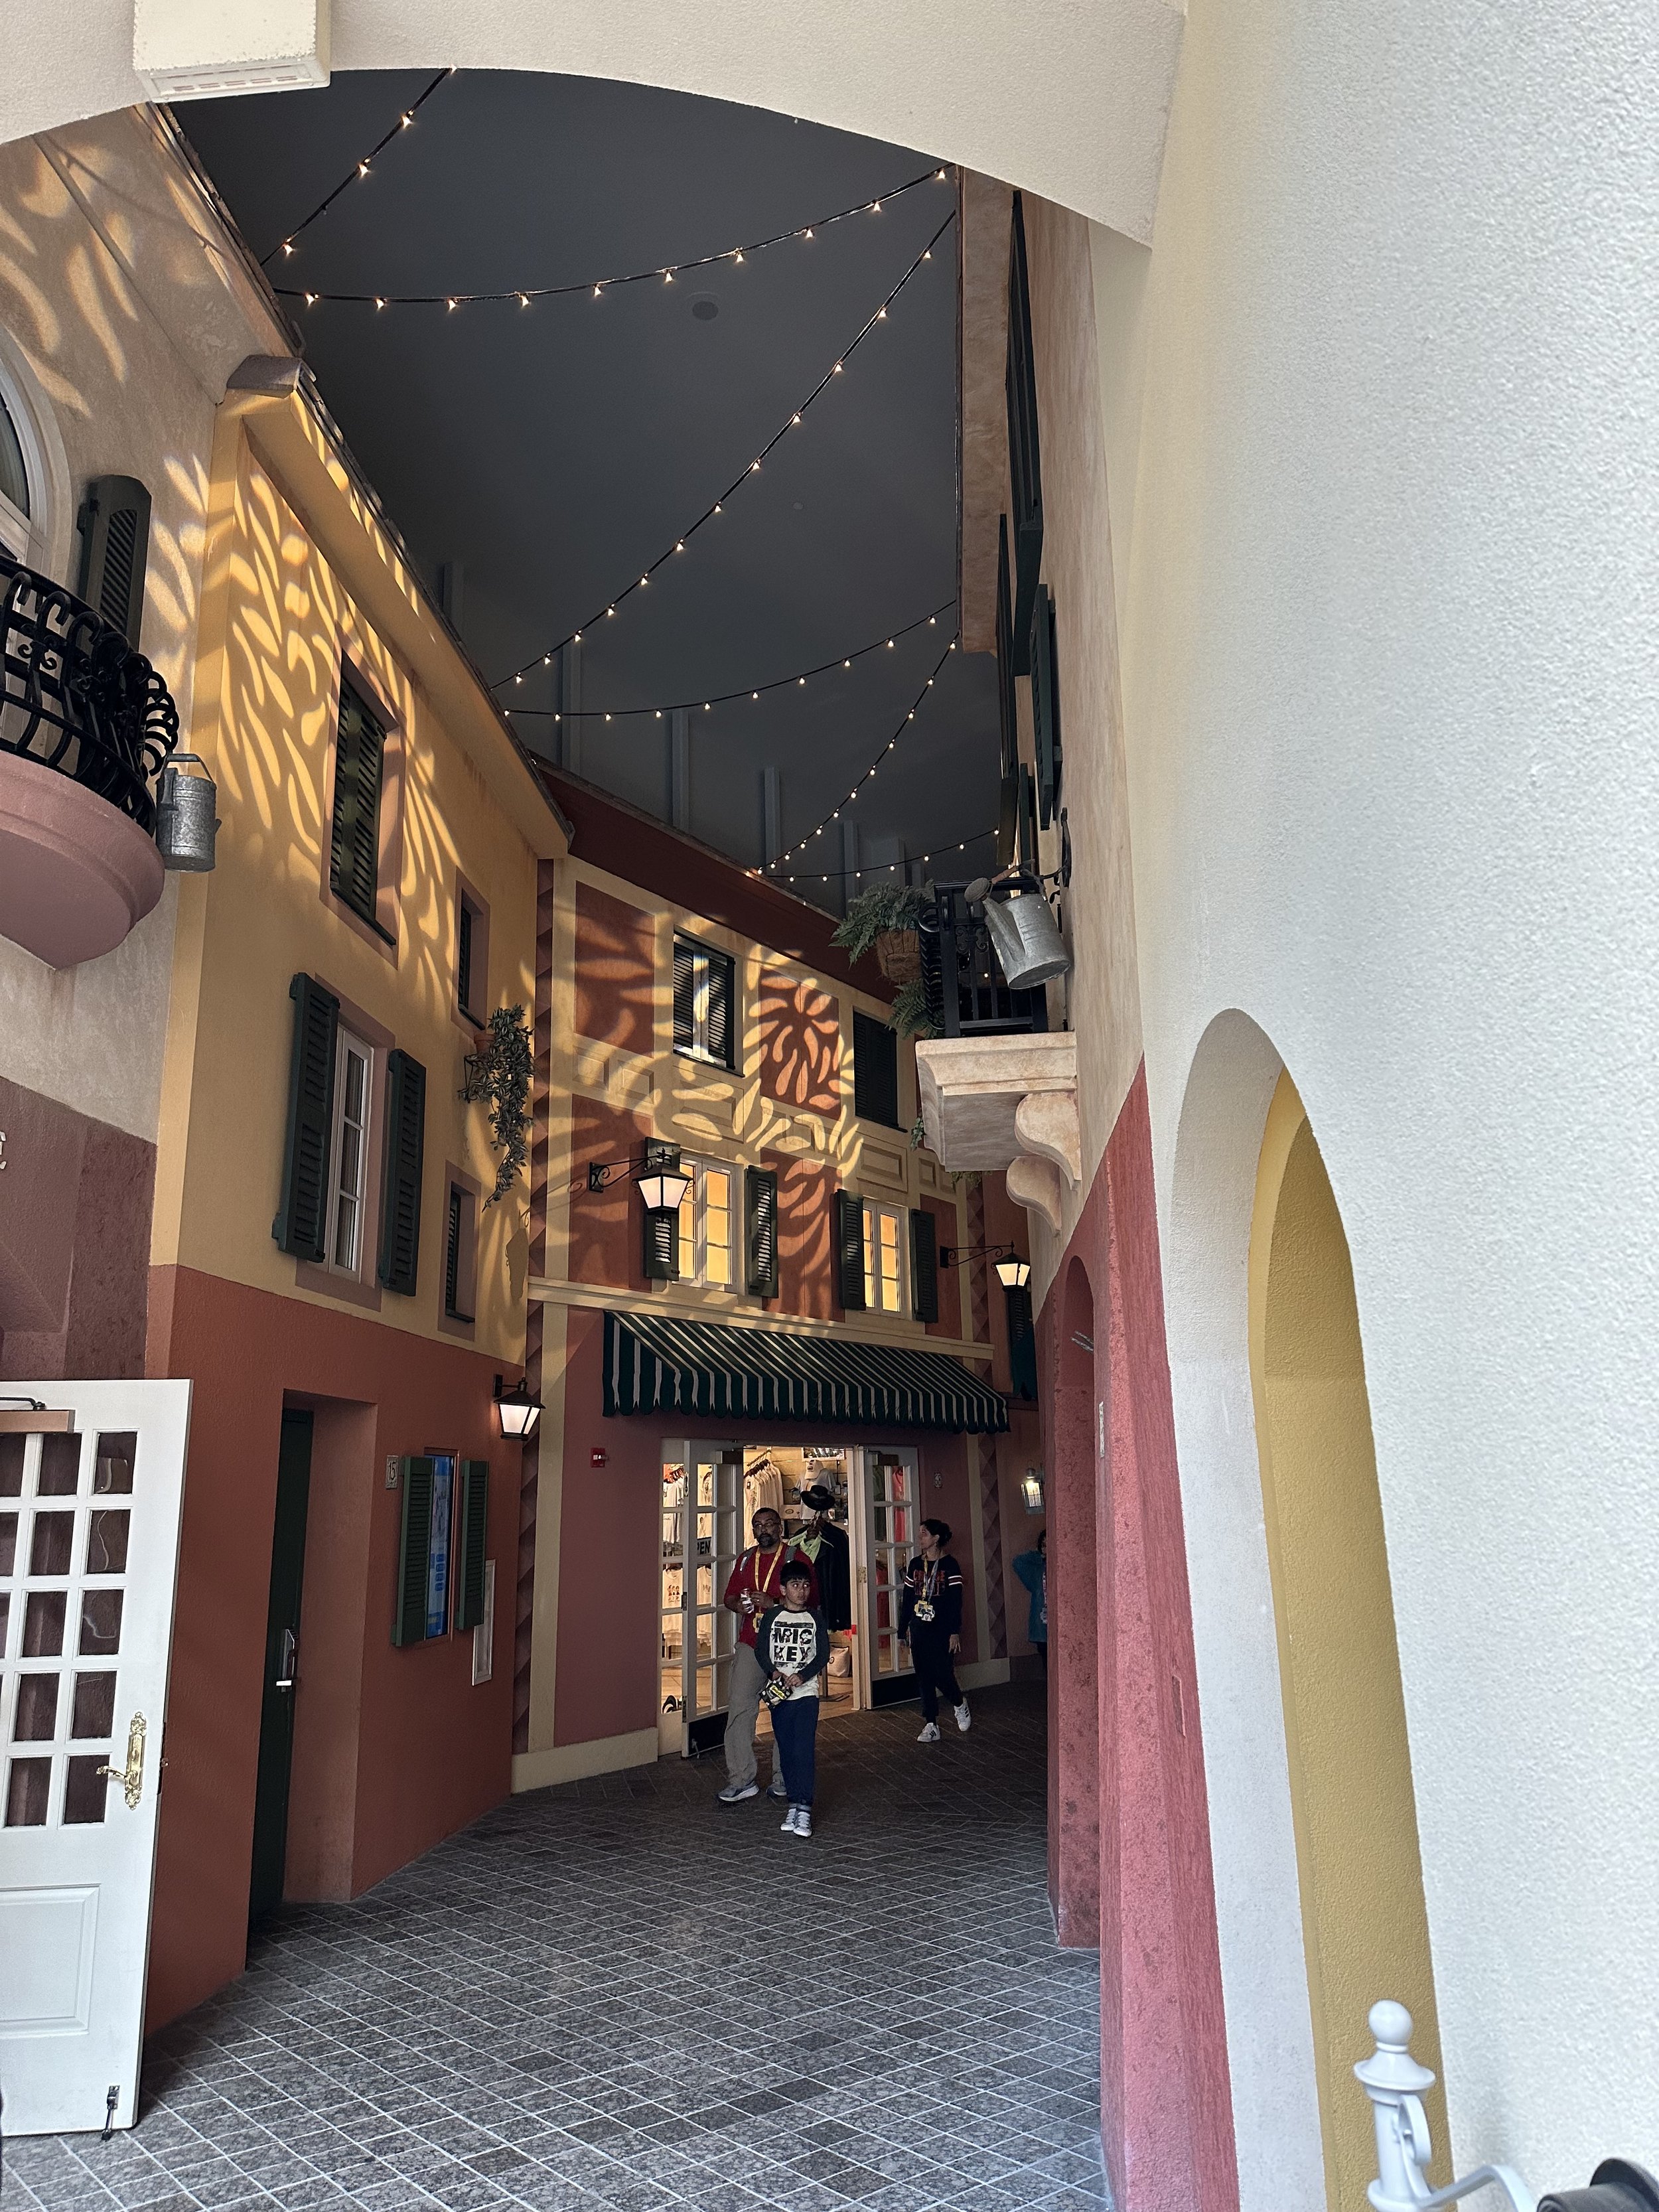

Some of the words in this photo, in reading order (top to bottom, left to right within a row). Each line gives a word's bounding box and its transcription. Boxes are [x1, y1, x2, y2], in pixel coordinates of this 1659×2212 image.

[389, 1461, 396, 1481] 15
[774, 1627, 812, 1645] MIC
[774, 1645, 811, 1662] KEY
